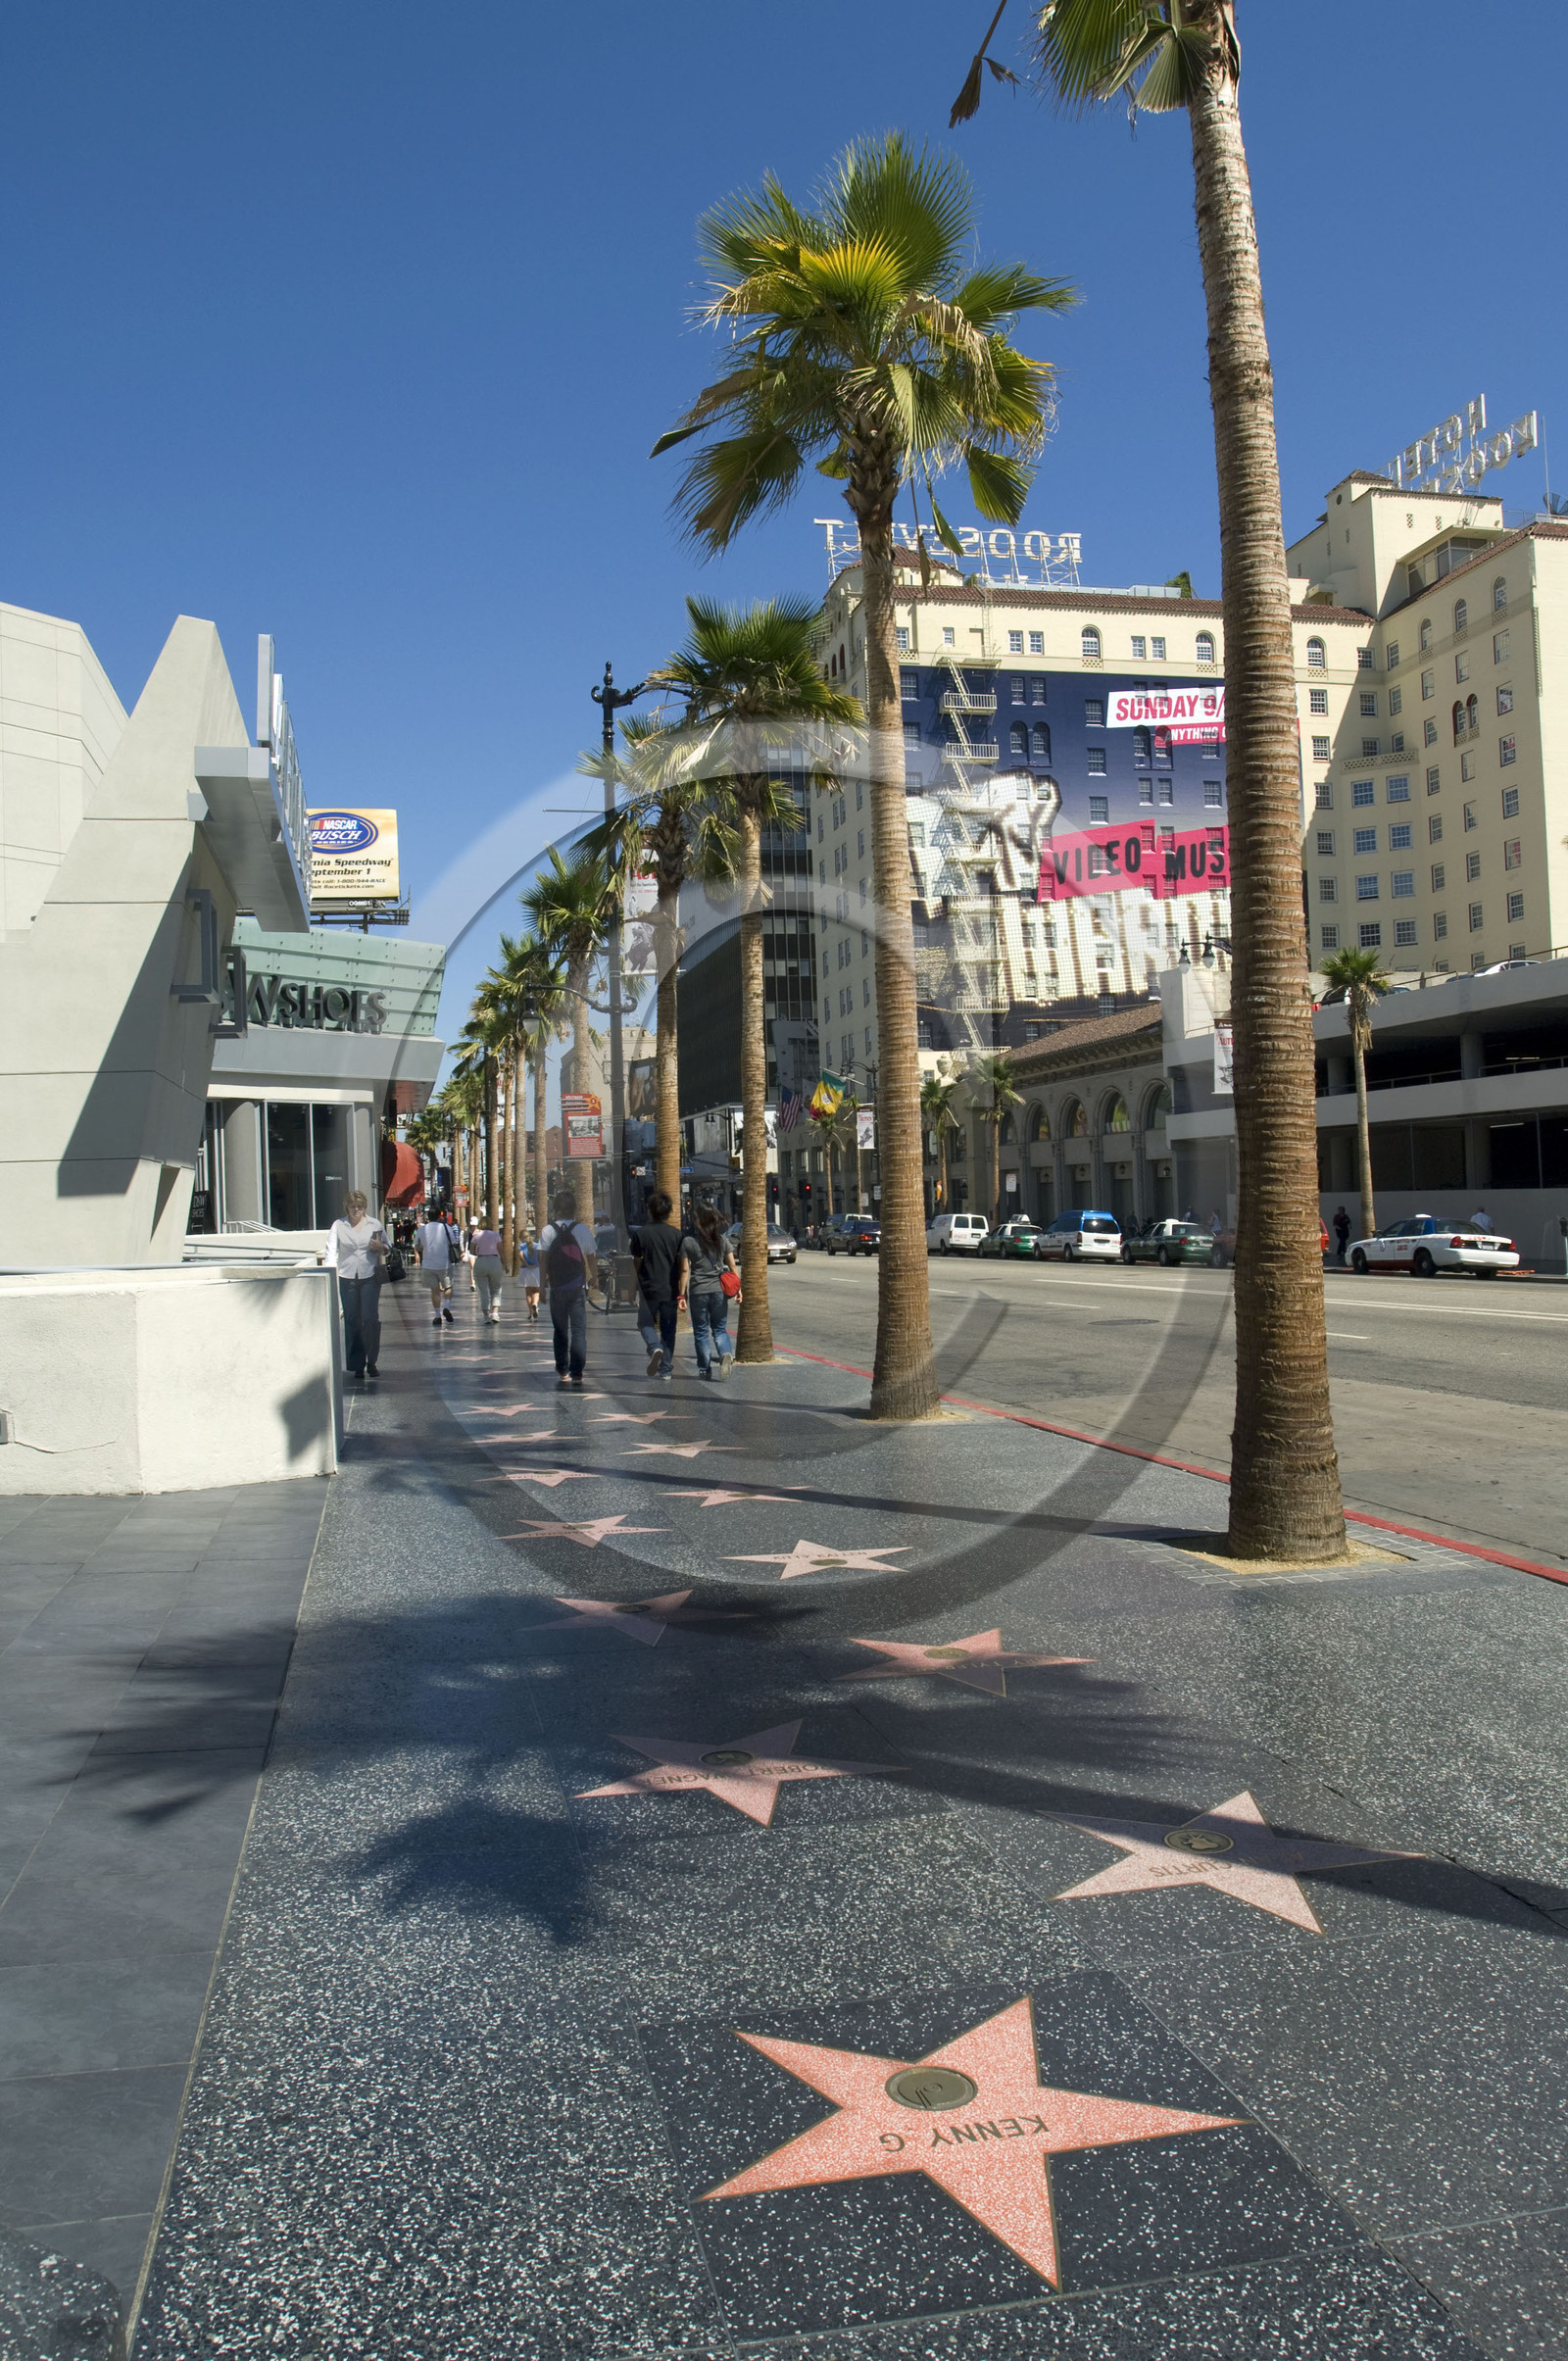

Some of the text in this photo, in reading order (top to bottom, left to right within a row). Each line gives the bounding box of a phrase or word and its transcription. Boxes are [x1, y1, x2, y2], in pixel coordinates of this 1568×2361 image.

[1116, 692, 1225, 721] SUNDAY 9/
[1165, 726, 1219, 742] ANYTHING
[323, 819, 357, 830] NASCAR
[312, 830, 363, 841] BUSCH
[334, 859, 391, 867] Speedway
[1053, 836, 1225, 886] VIDEO MUS
[1149, 1860, 1232, 1878] CURTIS
[879, 2115, 1050, 2152] KENNY G
